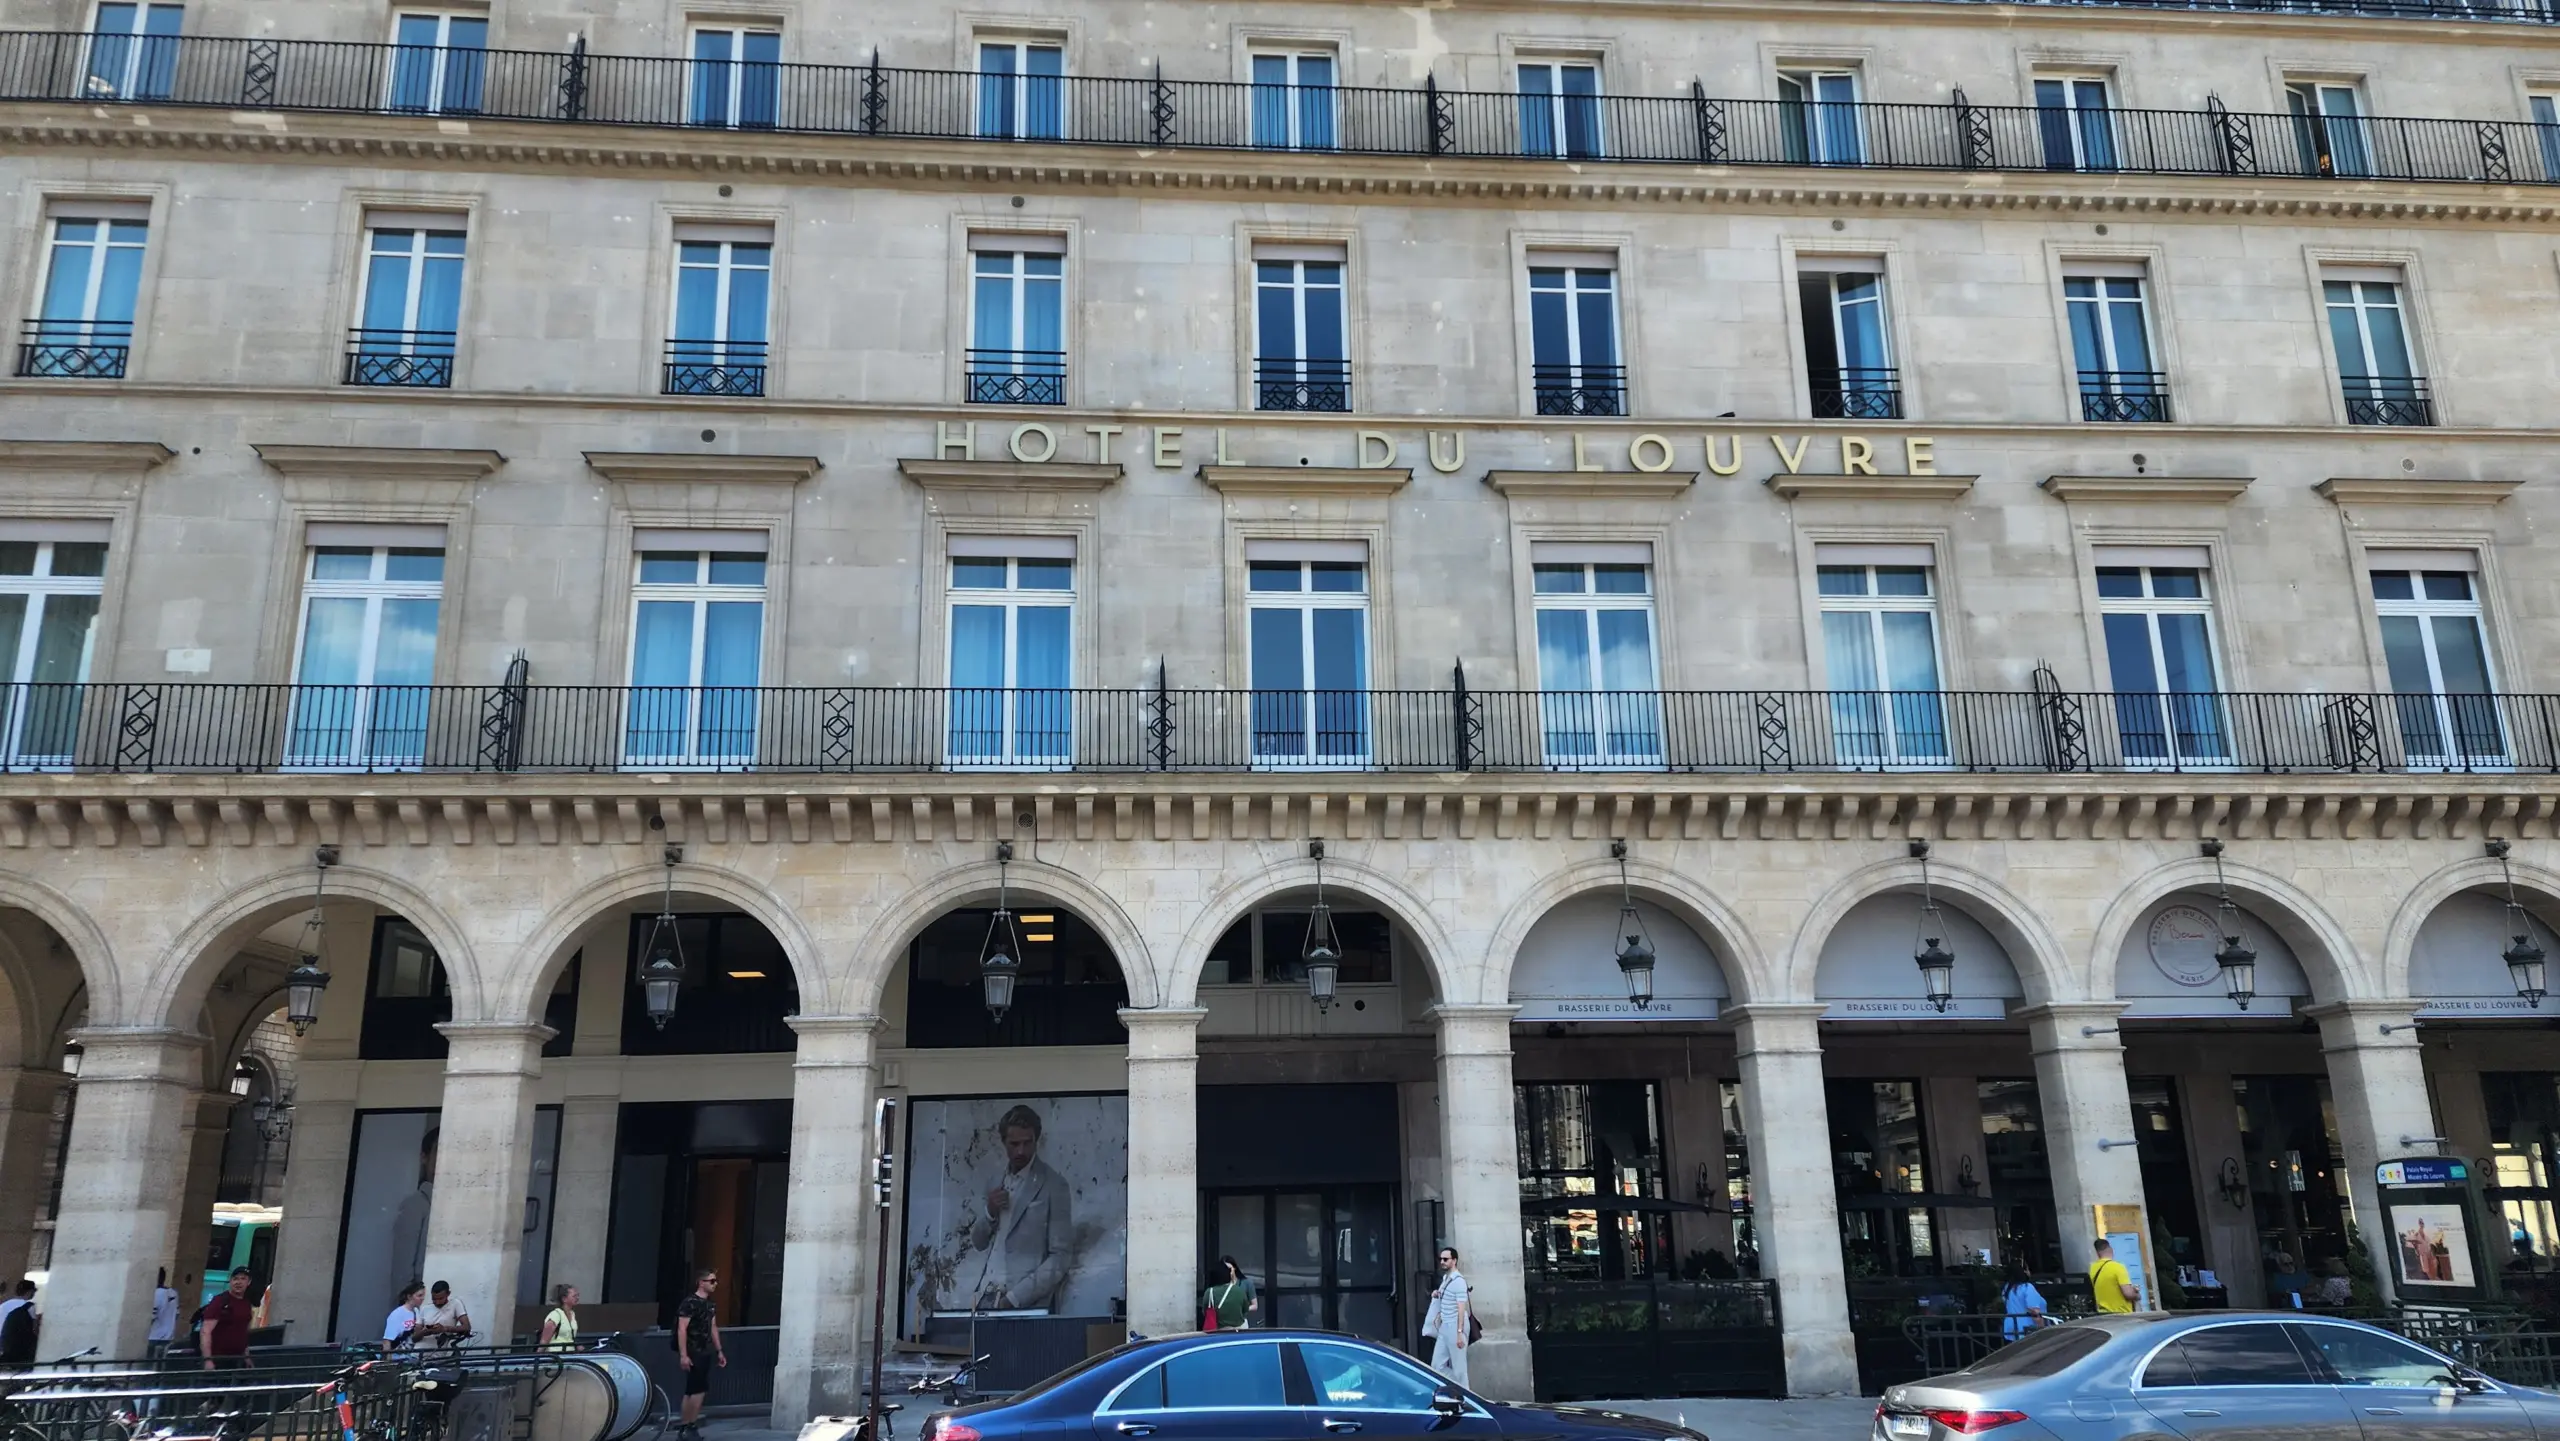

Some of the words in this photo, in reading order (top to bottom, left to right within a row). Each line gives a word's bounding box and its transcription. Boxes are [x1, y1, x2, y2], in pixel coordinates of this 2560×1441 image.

[936, 421, 1246, 468] HOTEL
[1357, 430, 1466, 473] DU
[1573, 433, 1938, 477] LOUVRE
[1558, 1004, 1611, 1012] BRASSERIE
[1614, 1004, 1629, 1012] DU
[1846, 1003, 1898, 1012] BRASSERIE
[1902, 1003, 1916, 1012] DU
[1920, 1003, 1959, 1012] LOURE
[2474, 1001, 2487, 1010] DU
[2491, 1001, 2528, 1010] LOUVRE
